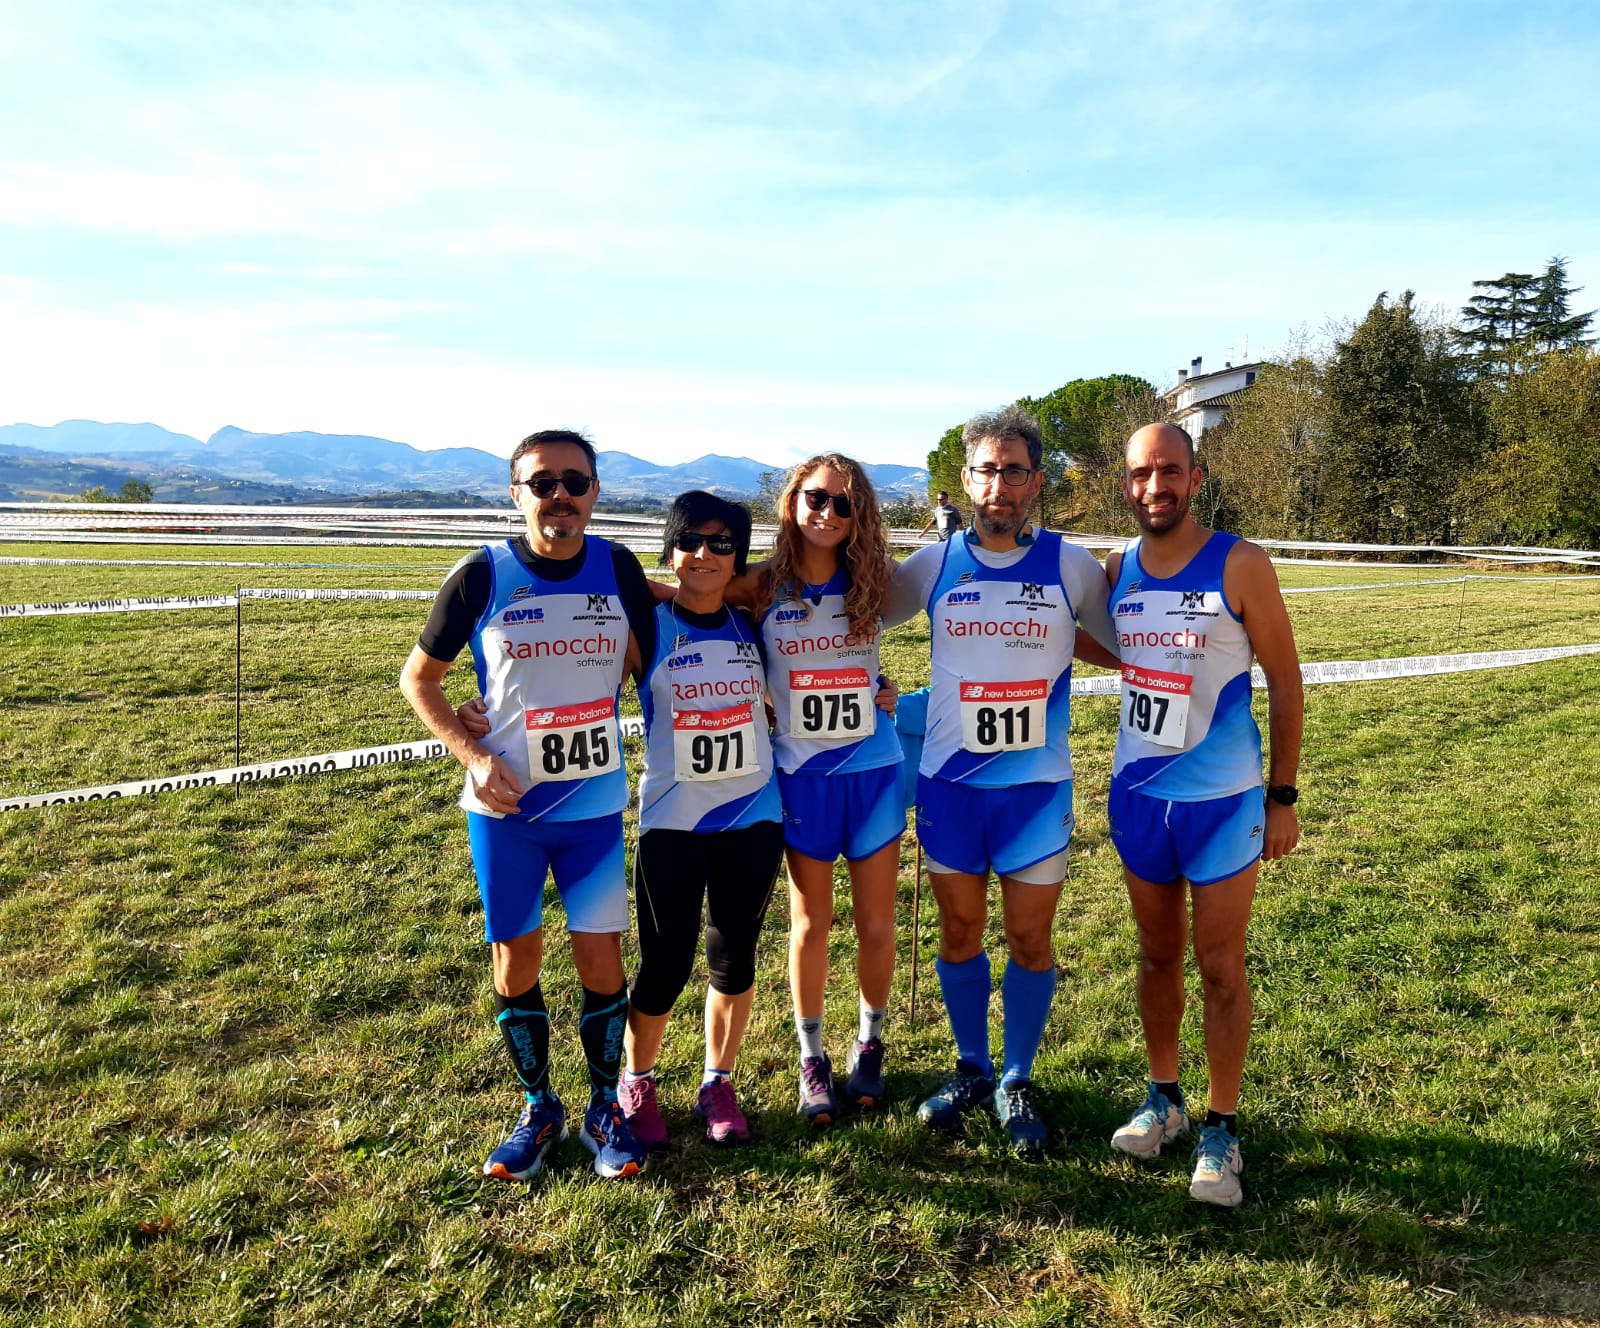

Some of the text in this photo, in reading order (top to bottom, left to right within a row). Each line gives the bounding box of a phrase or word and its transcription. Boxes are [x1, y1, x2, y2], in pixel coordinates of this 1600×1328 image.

[947, 592, 980, 602] AVIS
[1118, 602, 1144, 613] AVIS
[502, 607, 545, 623] AVIS
[775, 608, 809, 622] AVIS
[945, 618, 1048, 639] Ranocchi
[503, 633, 617, 659] Ranocchi
[1004, 639, 1046, 650] software
[836, 648, 873, 659] software
[1164, 651, 1206, 661] software
[576, 657, 614, 668] software
[814, 677, 833, 686] new
[835, 675, 868, 686] balance
[1147, 678, 1186, 691] balance
[984, 690, 1004, 698] new
[1006, 686, 1043, 698] balance
[555, 713, 577, 724] new
[579, 705, 611, 721] balance
[701, 718, 720, 727] new
[722, 712, 751, 726] balance
[802, 693, 861, 732] 975
[1129, 690, 1170, 736] 797
[977, 706, 1030, 746] 811
[541, 726, 610, 774] 845
[692, 731, 743, 775] 977
